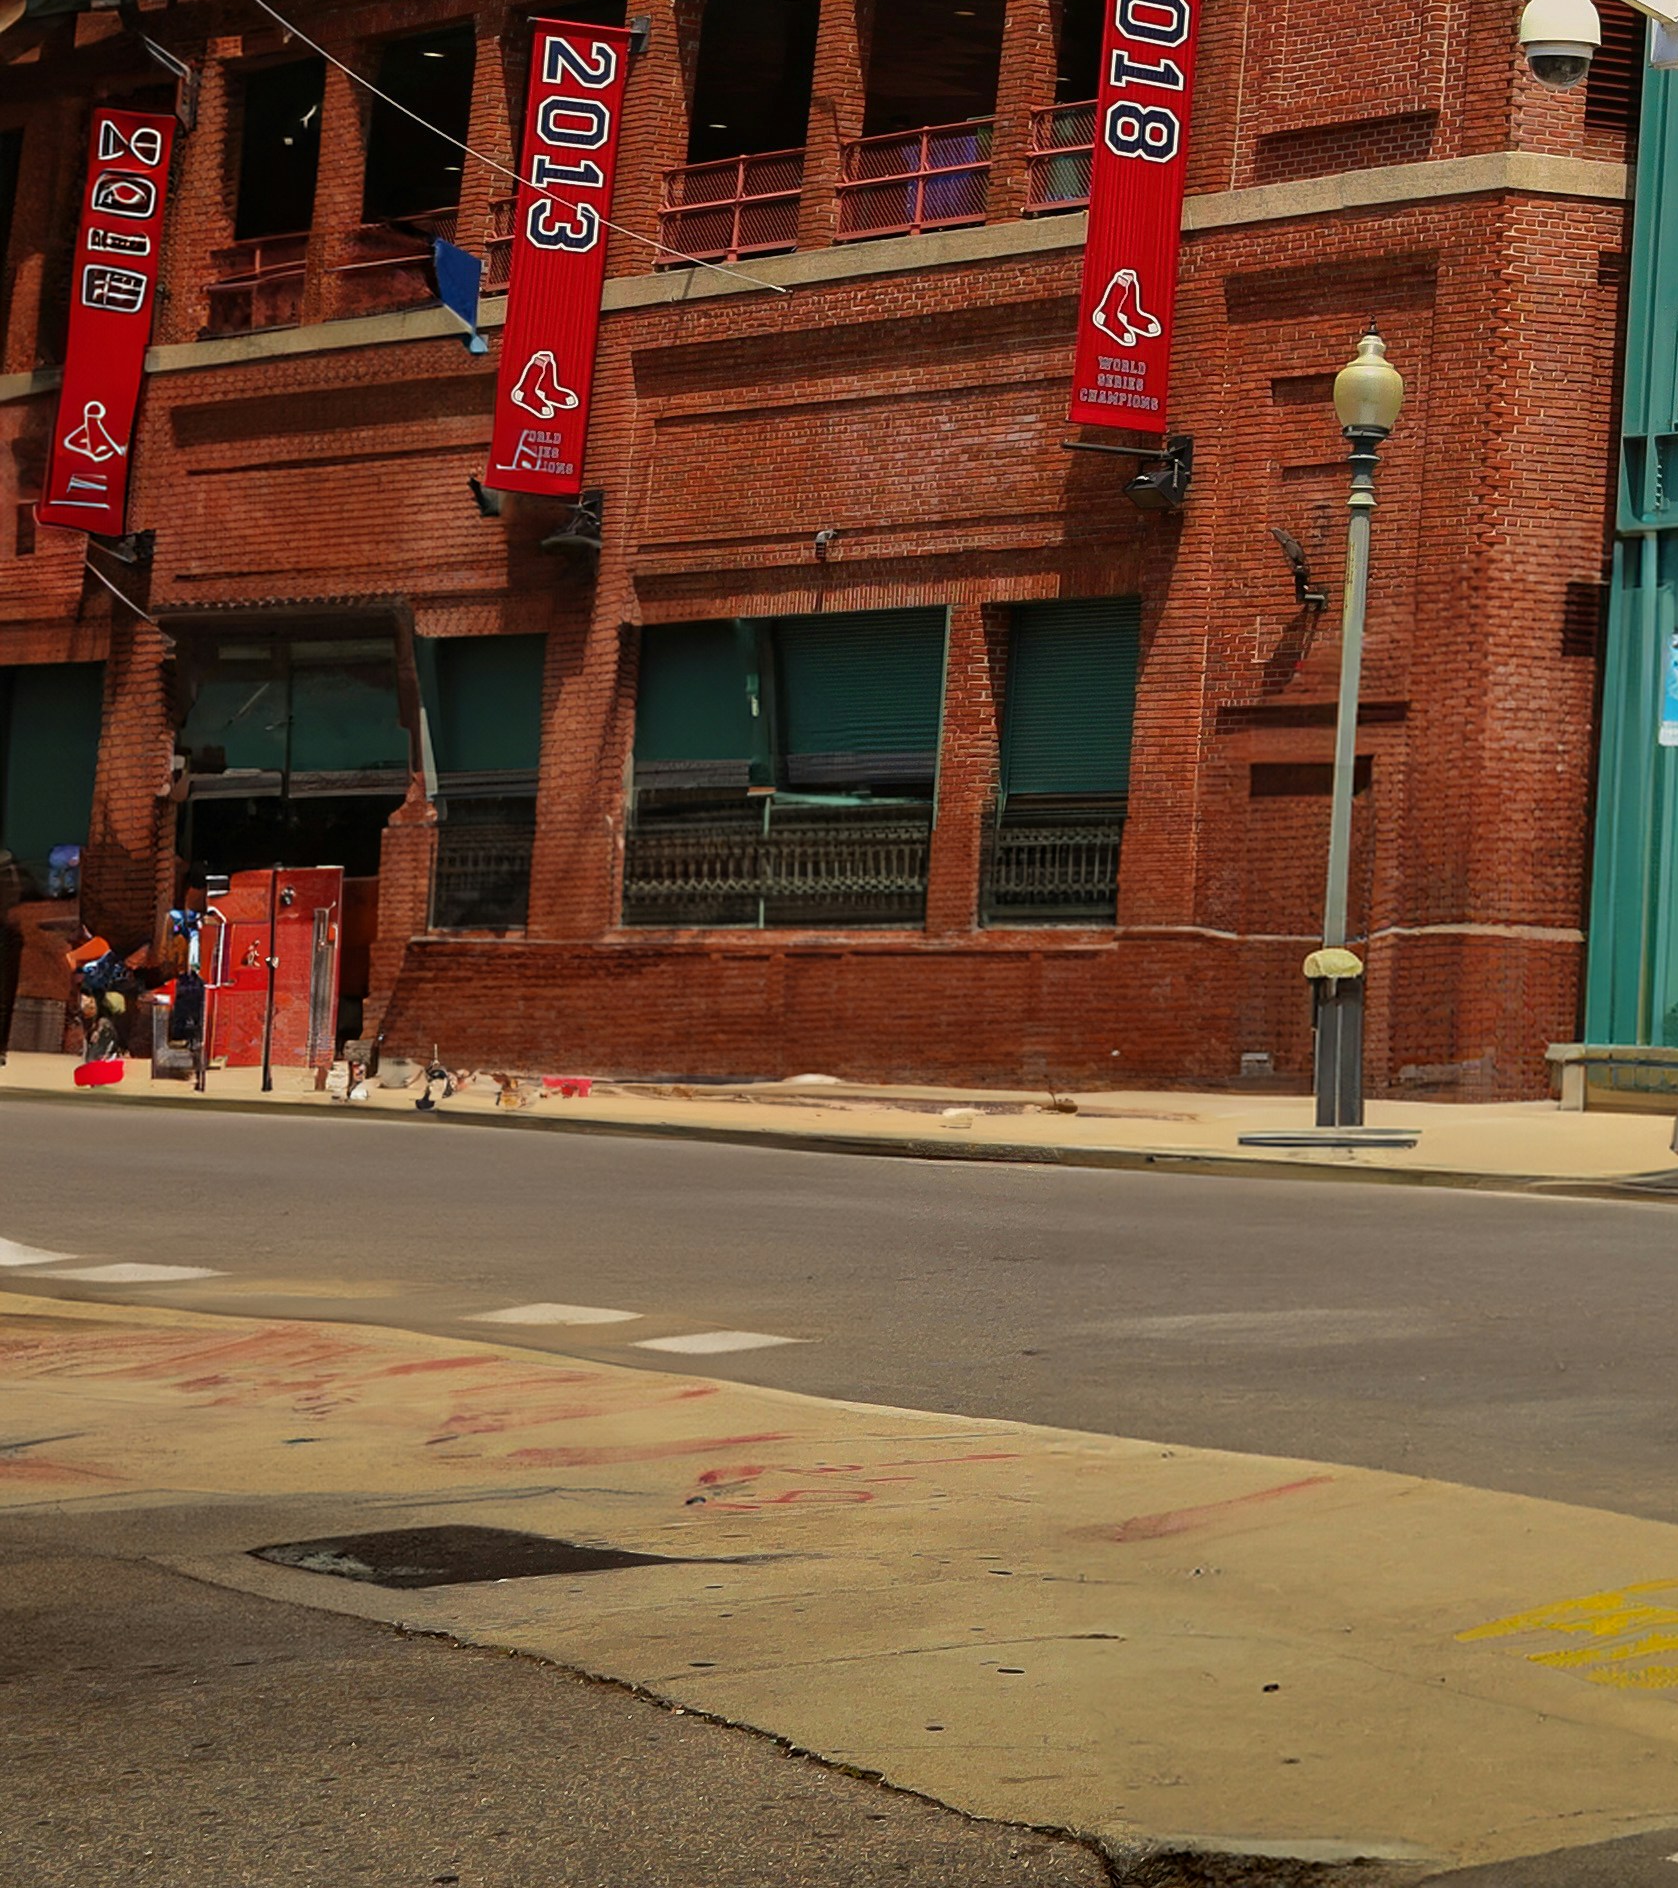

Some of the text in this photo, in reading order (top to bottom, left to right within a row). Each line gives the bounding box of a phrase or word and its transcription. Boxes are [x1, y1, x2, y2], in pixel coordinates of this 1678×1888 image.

[526, 36, 617, 253] 2013
[1098, 356, 1147, 375] WORLD
[1079, 388, 1159, 411] CHAMPIONS
